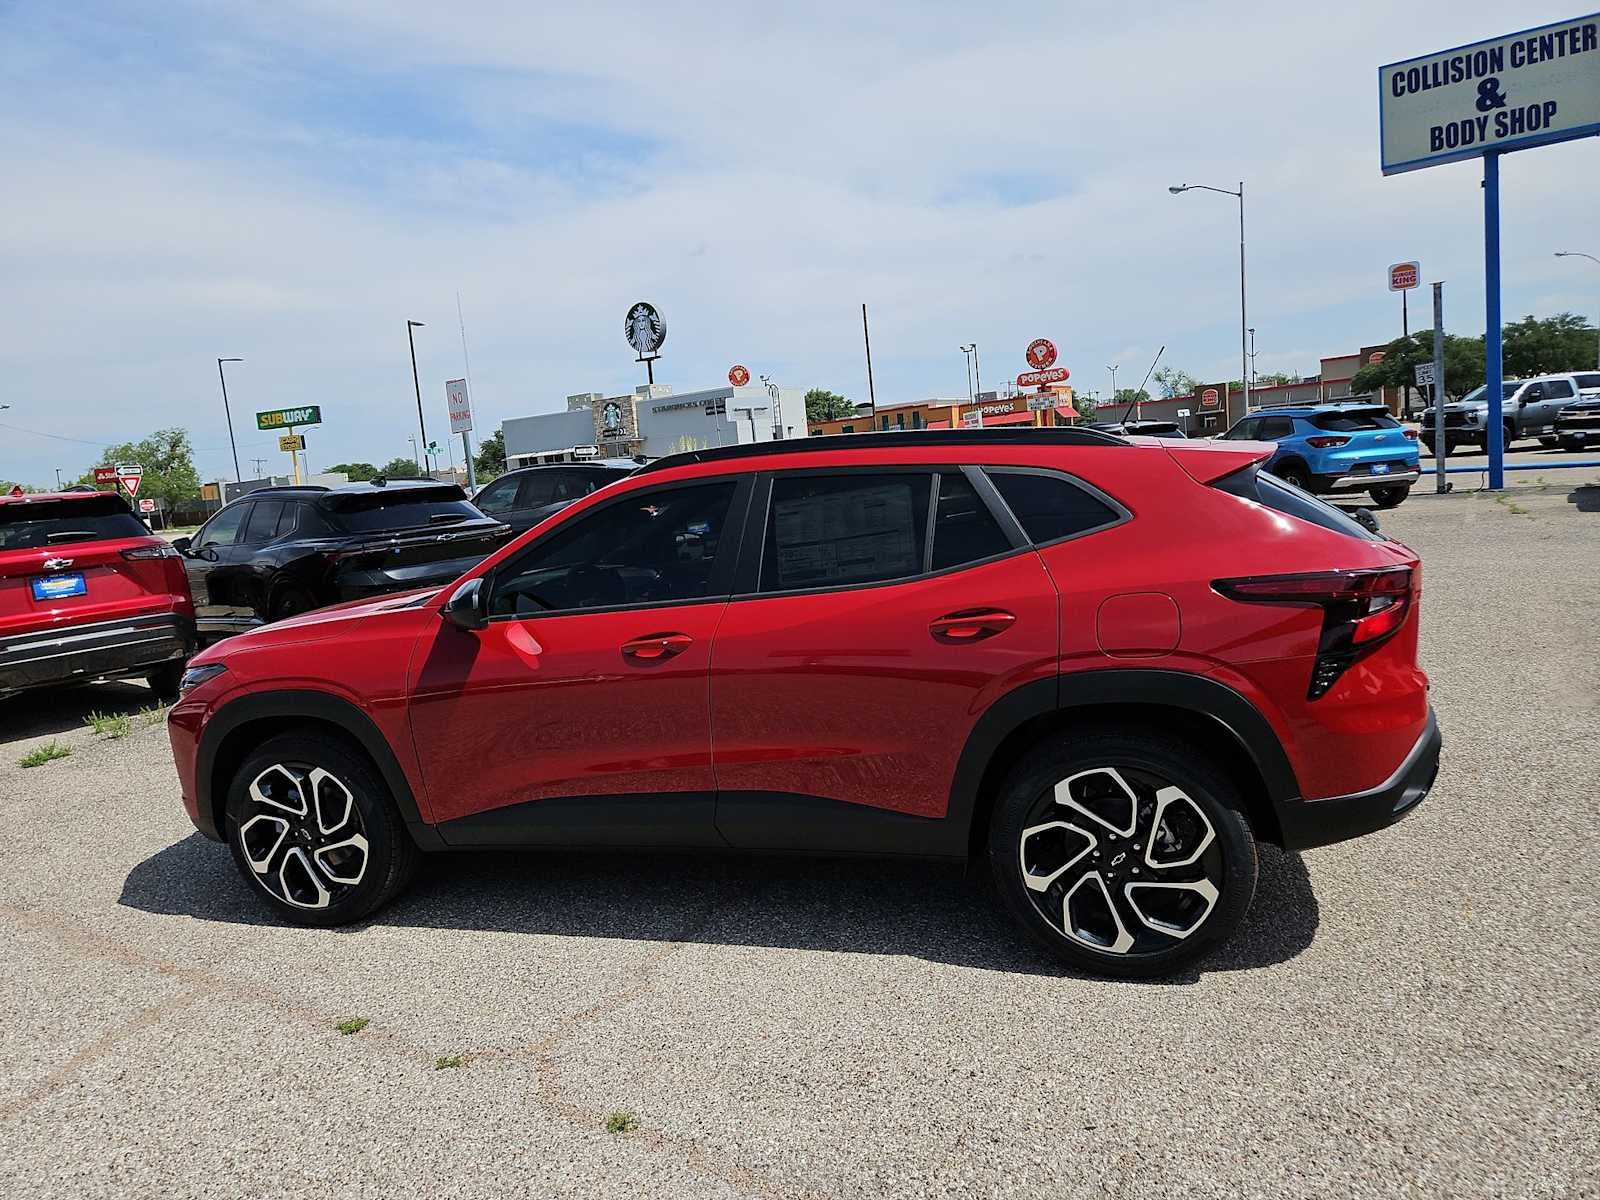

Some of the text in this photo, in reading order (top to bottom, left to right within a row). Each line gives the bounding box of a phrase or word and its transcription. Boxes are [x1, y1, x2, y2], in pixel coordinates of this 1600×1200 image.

[1392, 23, 1598, 98] COLLISION CENTER
[1475, 77, 1506, 112] &
[1430, 100, 1557, 152] BODY SHOP
[1392, 275, 1416, 285] KING
[1418, 375, 1434, 384] 35
[452, 391, 463, 404] NO
[651, 400, 698, 414] STARBUCKS
[260, 409, 313, 427] SUBWAY
[450, 410, 471, 422] PARKING
